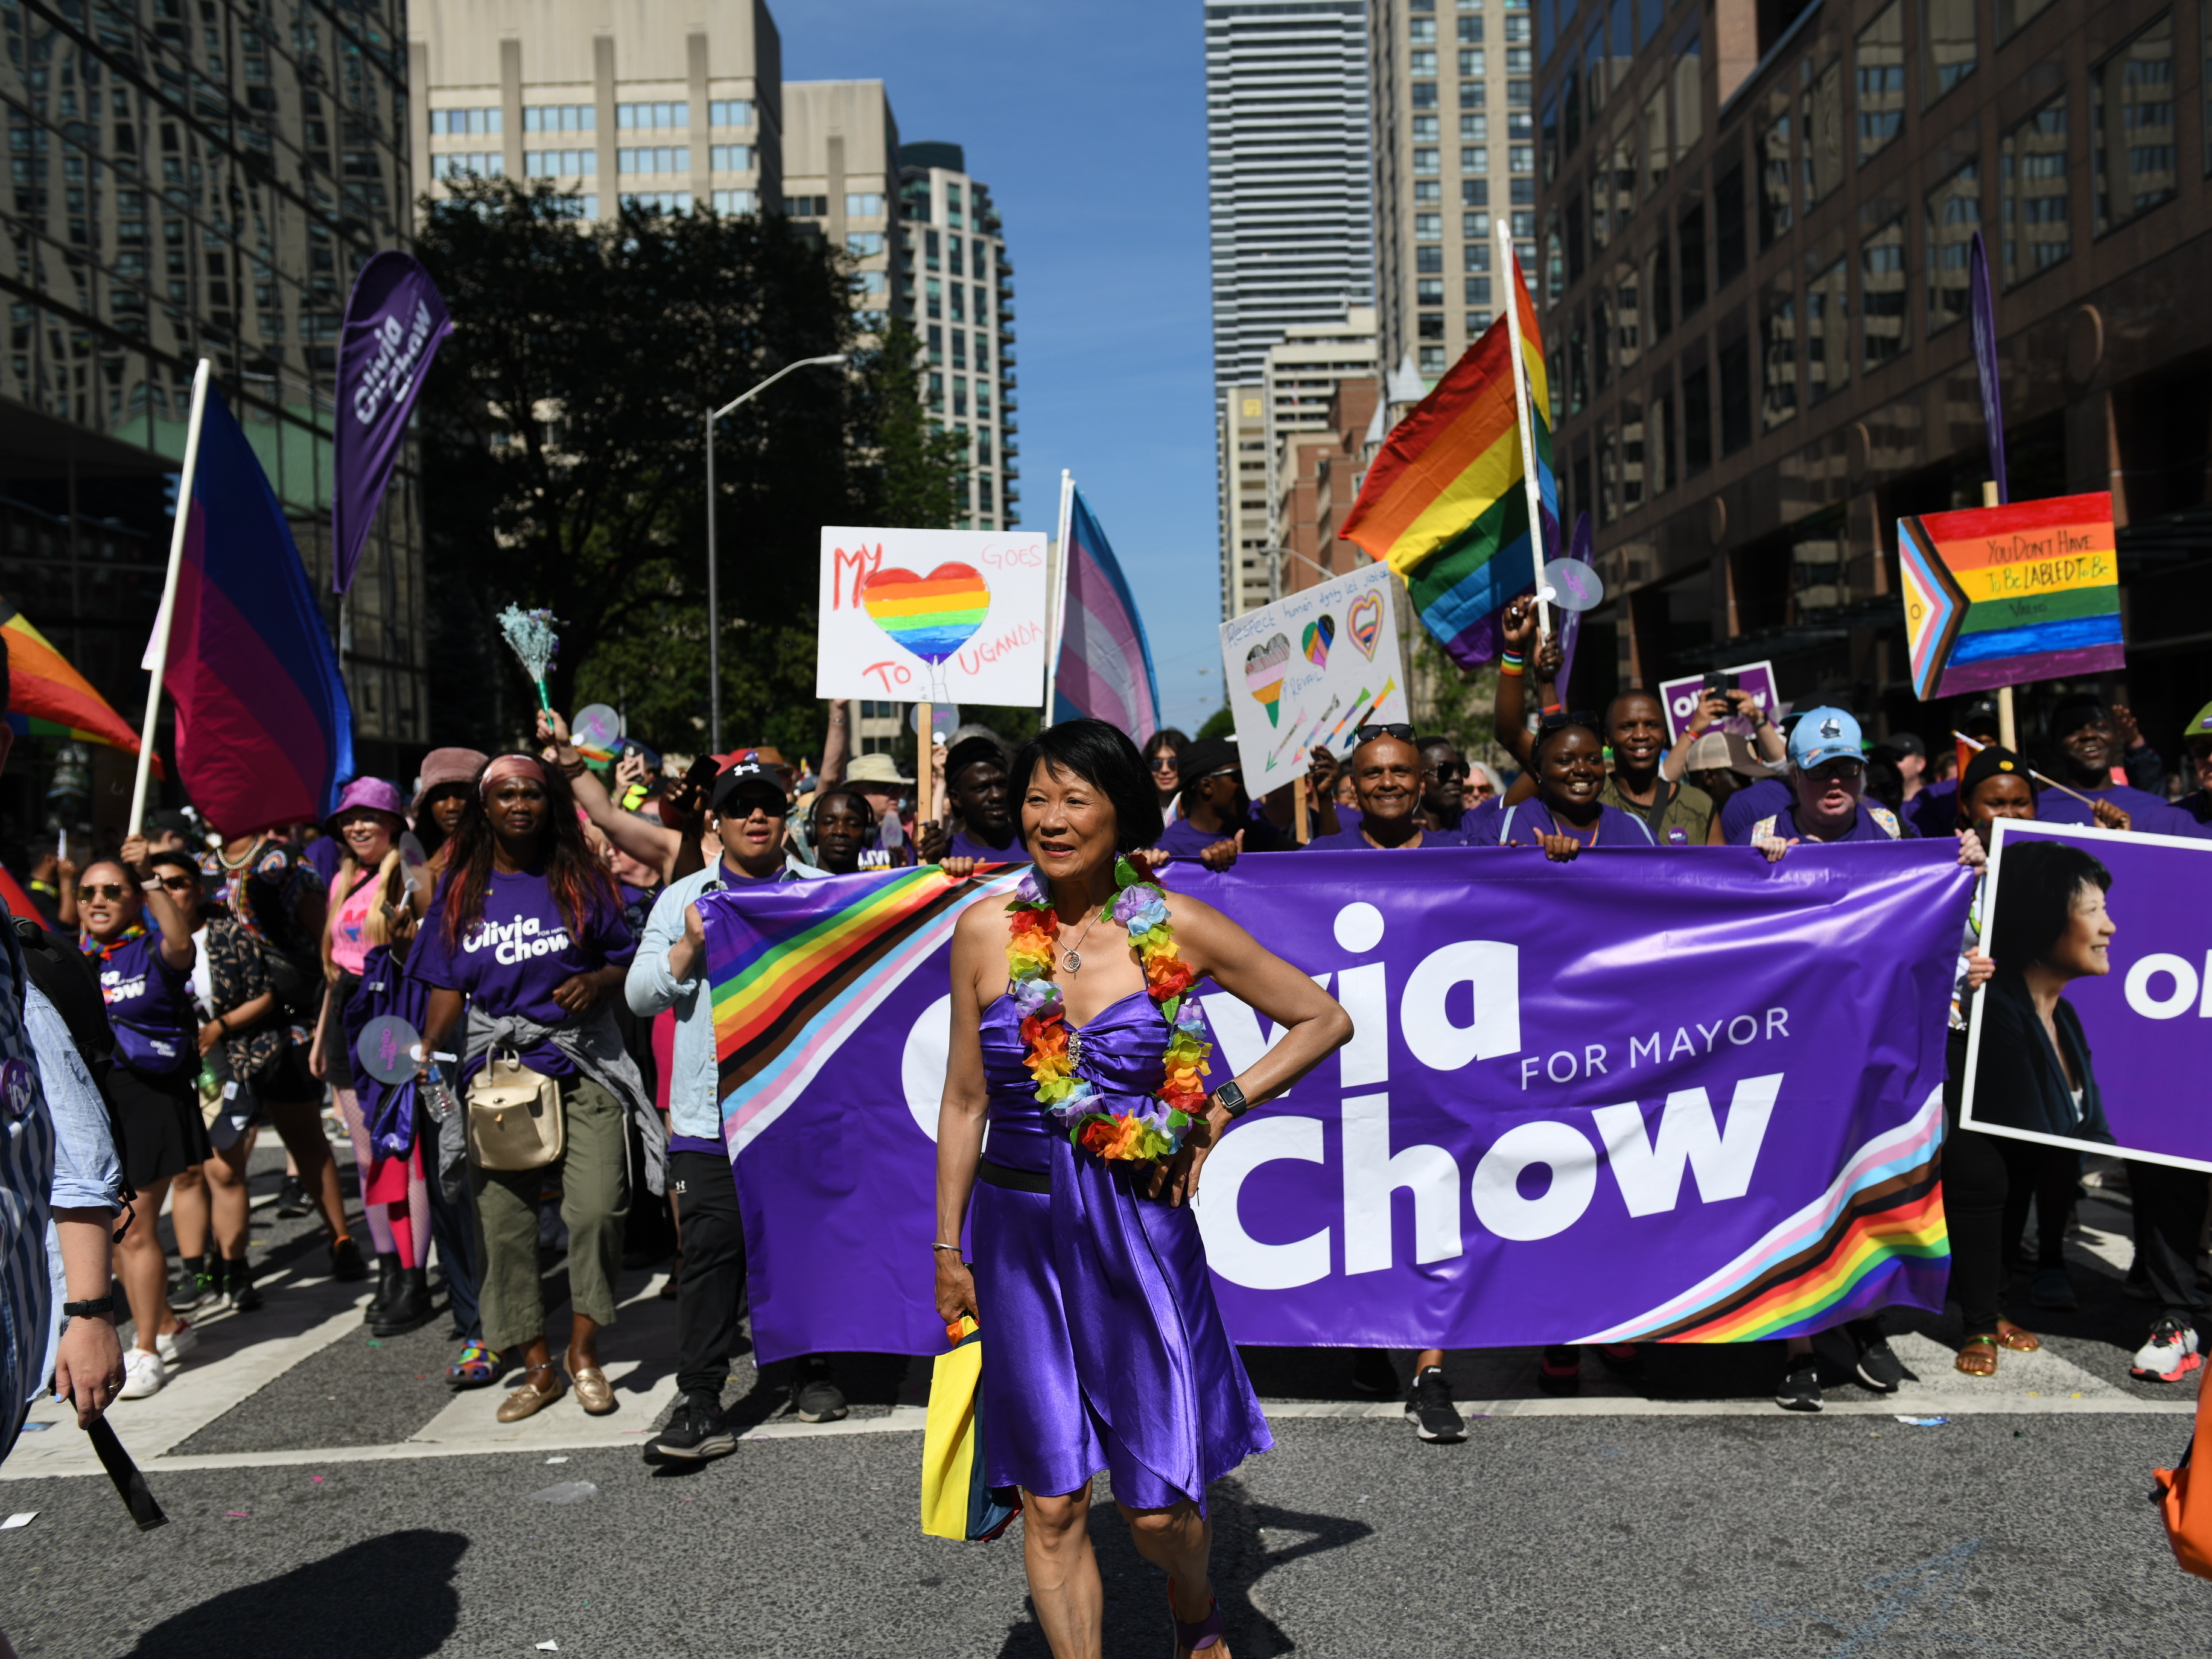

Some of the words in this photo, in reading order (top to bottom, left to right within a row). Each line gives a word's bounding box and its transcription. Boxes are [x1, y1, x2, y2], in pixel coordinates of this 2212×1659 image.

[354, 315, 404, 424] Olivia
[833, 543, 882, 611] MY
[982, 544, 1042, 570] GOES
[958, 621, 1044, 675] UGANDA
[862, 661, 911, 694] TO
[495, 934, 569, 965] Chow
[550, 926, 568, 935] MAYO
[1521, 1043, 1607, 1091] FOR
[1629, 1007, 1790, 1069] MAYOR
[1186, 1072, 1784, 1290] Chow
